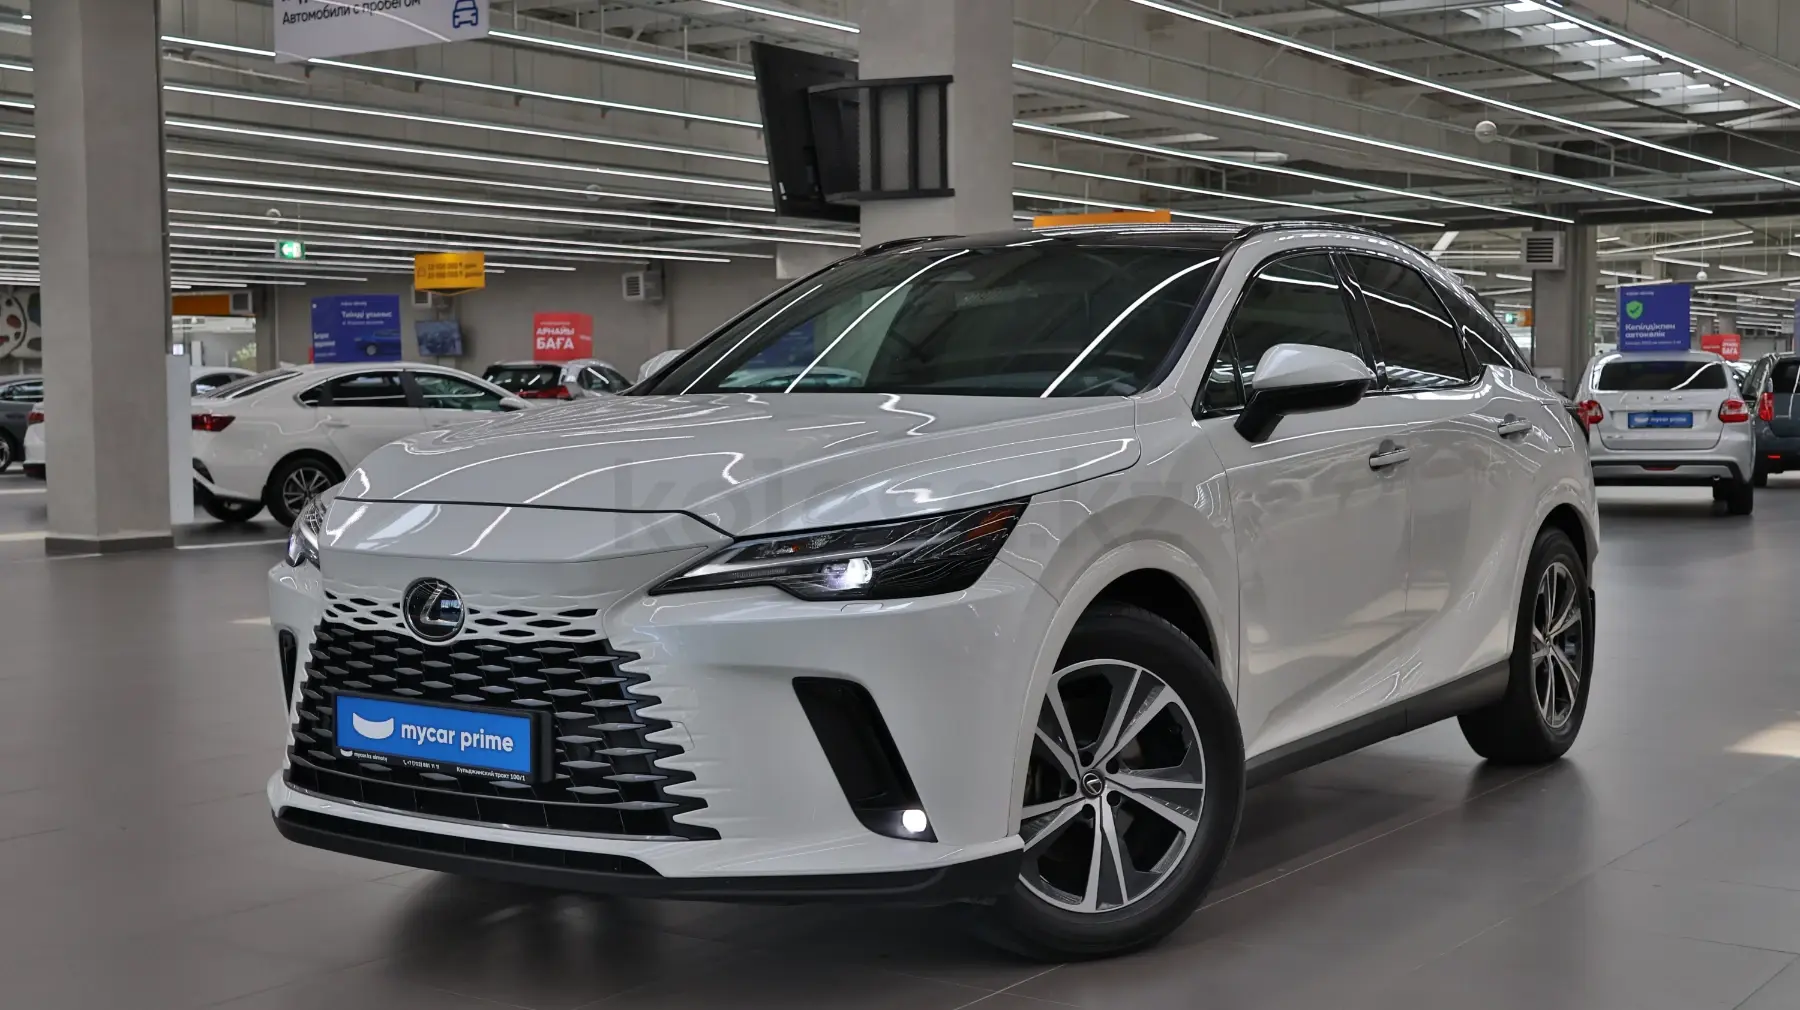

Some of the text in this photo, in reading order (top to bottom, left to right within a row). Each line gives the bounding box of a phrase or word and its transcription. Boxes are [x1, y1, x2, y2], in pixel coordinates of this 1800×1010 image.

[282, 4, 351, 25] Автомобили
[536, 337, 575, 350] БАҒА
[400, 723, 514, 753] mycar prime
